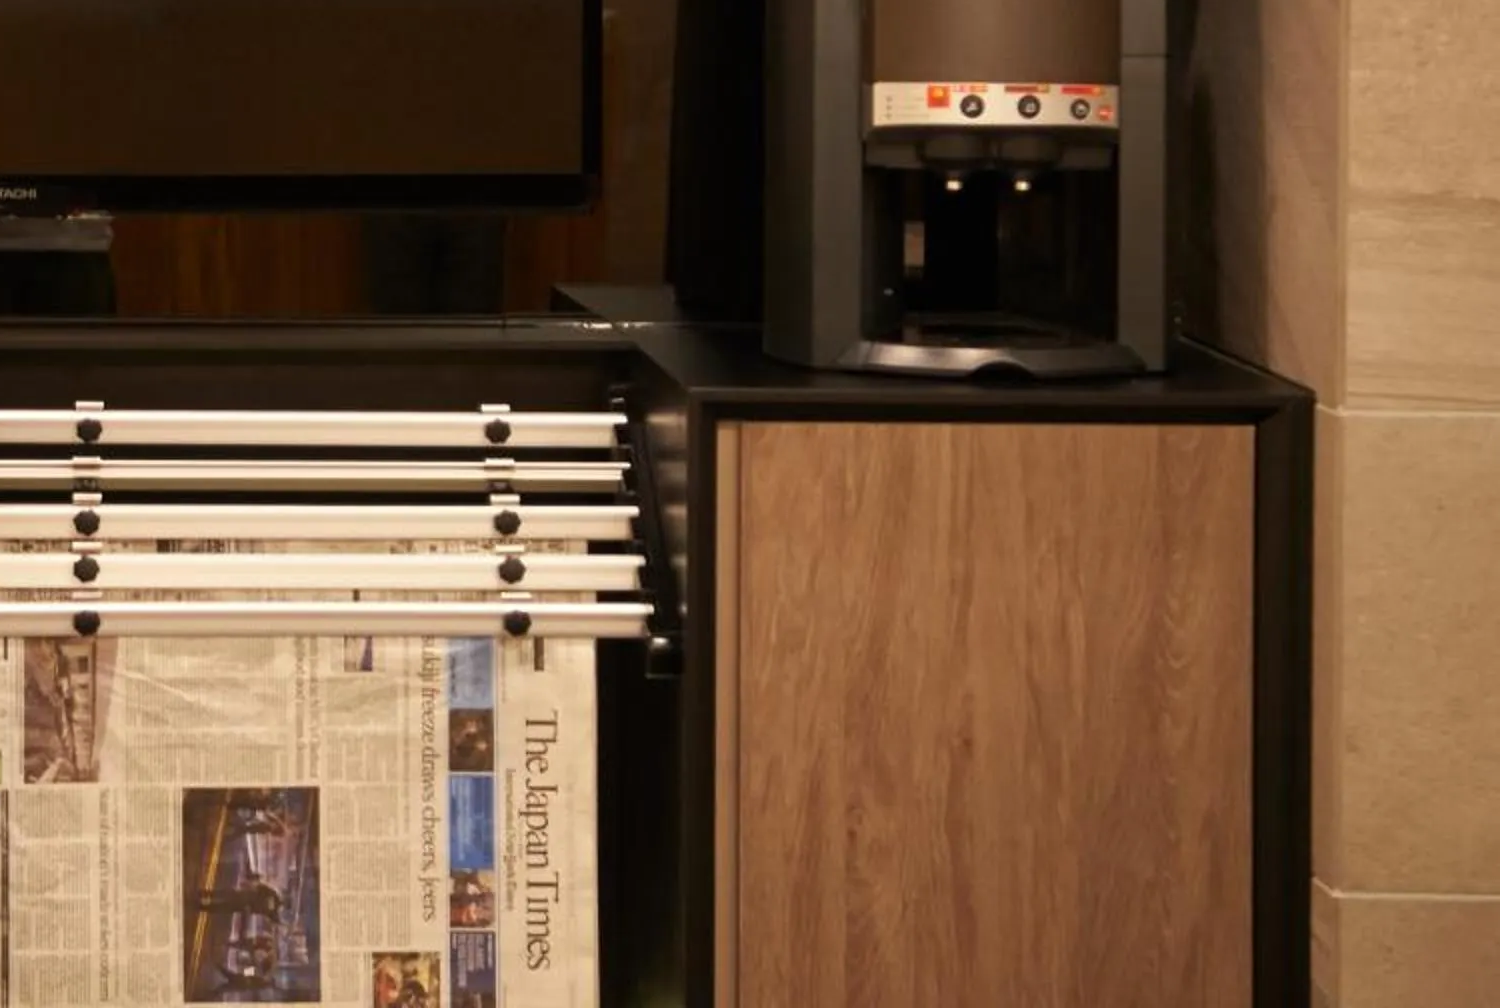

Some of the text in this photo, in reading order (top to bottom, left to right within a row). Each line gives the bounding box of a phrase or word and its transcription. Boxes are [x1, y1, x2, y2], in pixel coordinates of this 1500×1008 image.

[421, 686, 441, 744] freeze
[421, 746, 442, 803] draws
[518, 709, 560, 972] The Japan Times
[418, 876, 442, 923] jeers
